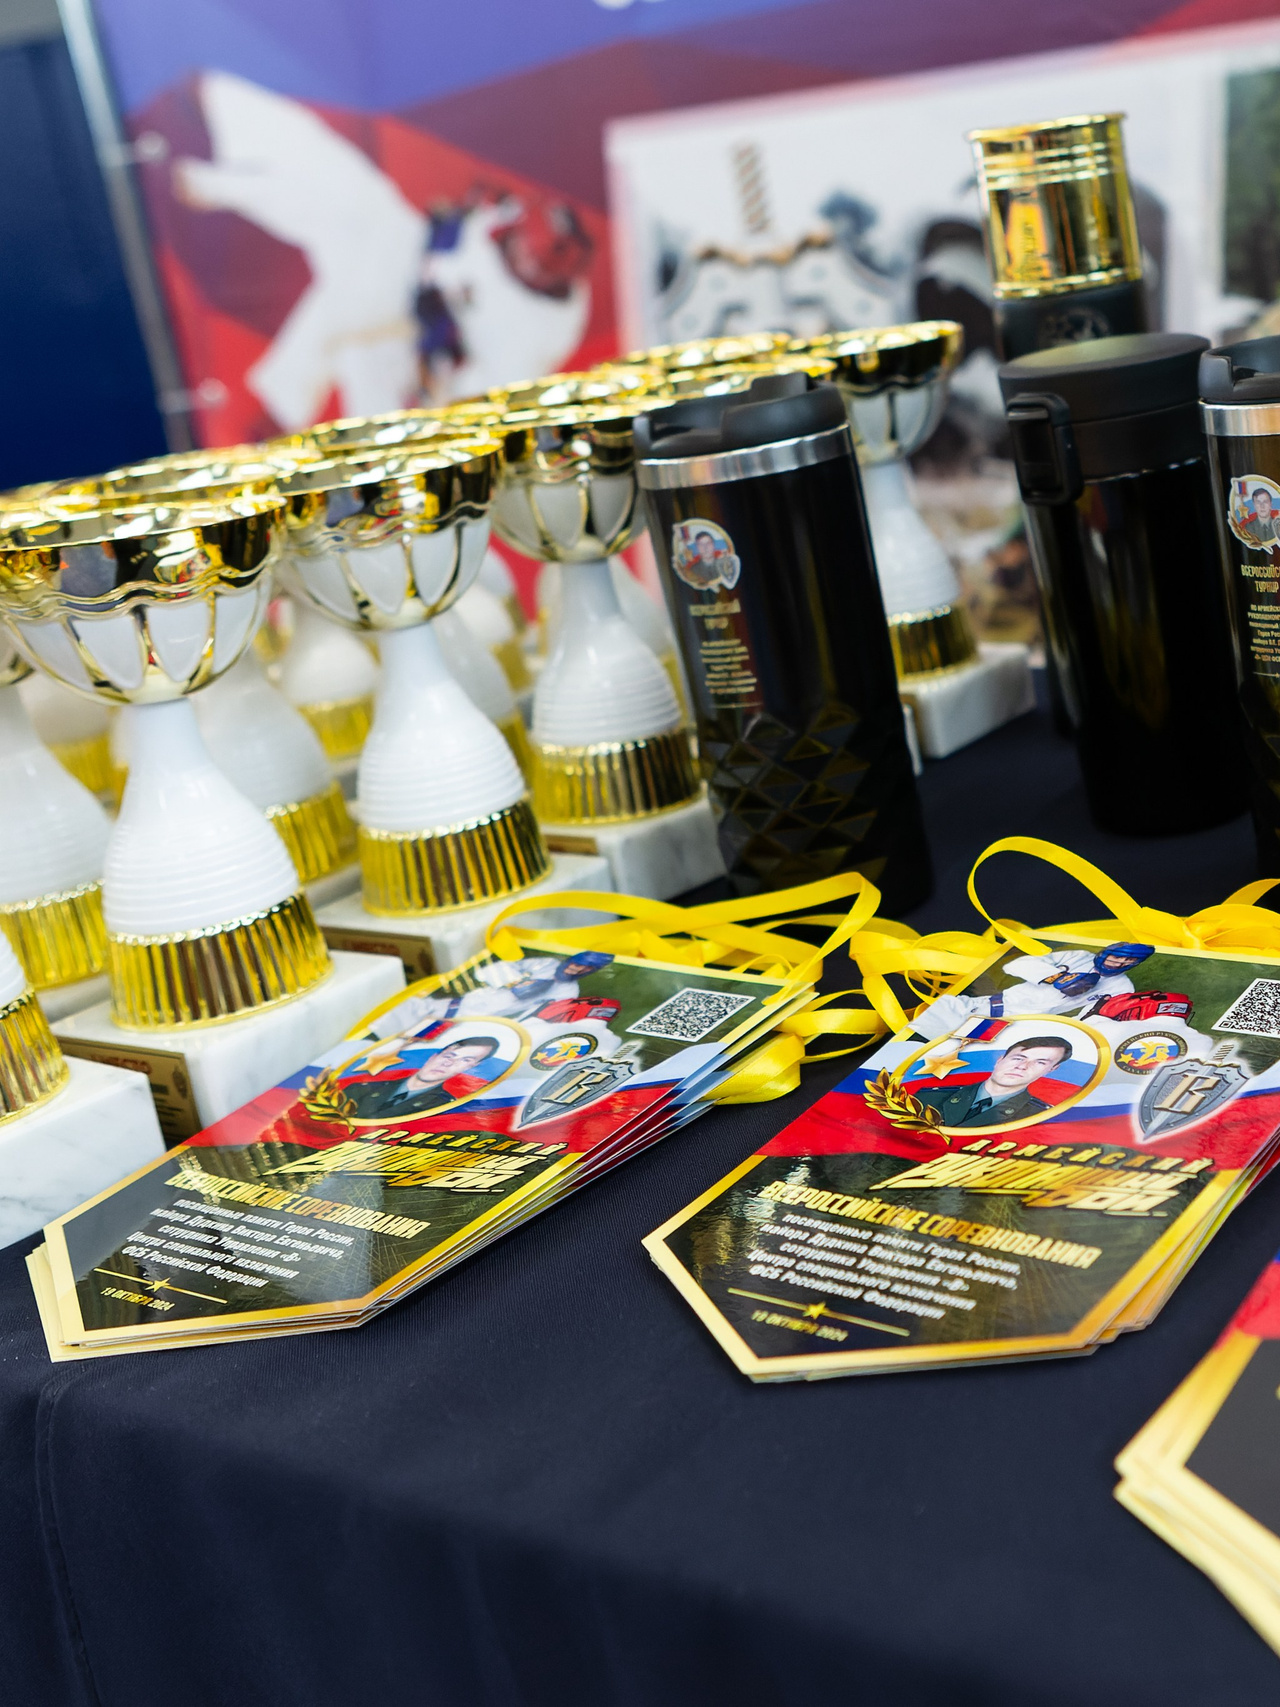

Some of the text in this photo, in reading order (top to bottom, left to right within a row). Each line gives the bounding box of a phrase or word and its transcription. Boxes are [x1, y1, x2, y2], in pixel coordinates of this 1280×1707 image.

[1254, 580, 1279, 593] ТУРНИР
[360, 1128, 568, 1155] АРМЕЙСКИЙ
[962, 1139, 1214, 1174] АРМЕЙСКИЙ
[164, 1169, 431, 1239] ВСЕРОССИЙСКИЕ СОРЕВНОВАНИЯ
[758, 1180, 1102, 1270] ВСЕРОССИЙСКИЕ СОРЕВНОВАНИЯ
[150, 1208, 344, 1260] майора Дудкина Виктора Евгеньевича,
[158, 1224, 219, 1244] сотрудника
[215, 1236, 281, 1259] Управления
[241, 1212, 283, 1229] памяти
[280, 1221, 314, 1236] Героя
[311, 1228, 355, 1247] России,
[760, 1223, 810, 1241] майора
[807, 1232, 869, 1254] Дудкина
[868, 1244, 926, 1267] Виктора
[782, 1214, 1021, 1276] посвященные памяти Героя России,
[121, 1245, 269, 1288] ФСБ Российской Федерации
[126, 1231, 300, 1279] Центра специального назначения
[780, 1242, 857, 1267] сотрудника
[856, 1257, 941, 1287] Управления
[747, 1248, 977, 1312] Центра специального назначения
[749, 1264, 946, 1320] ФСБ Российской Федерации
